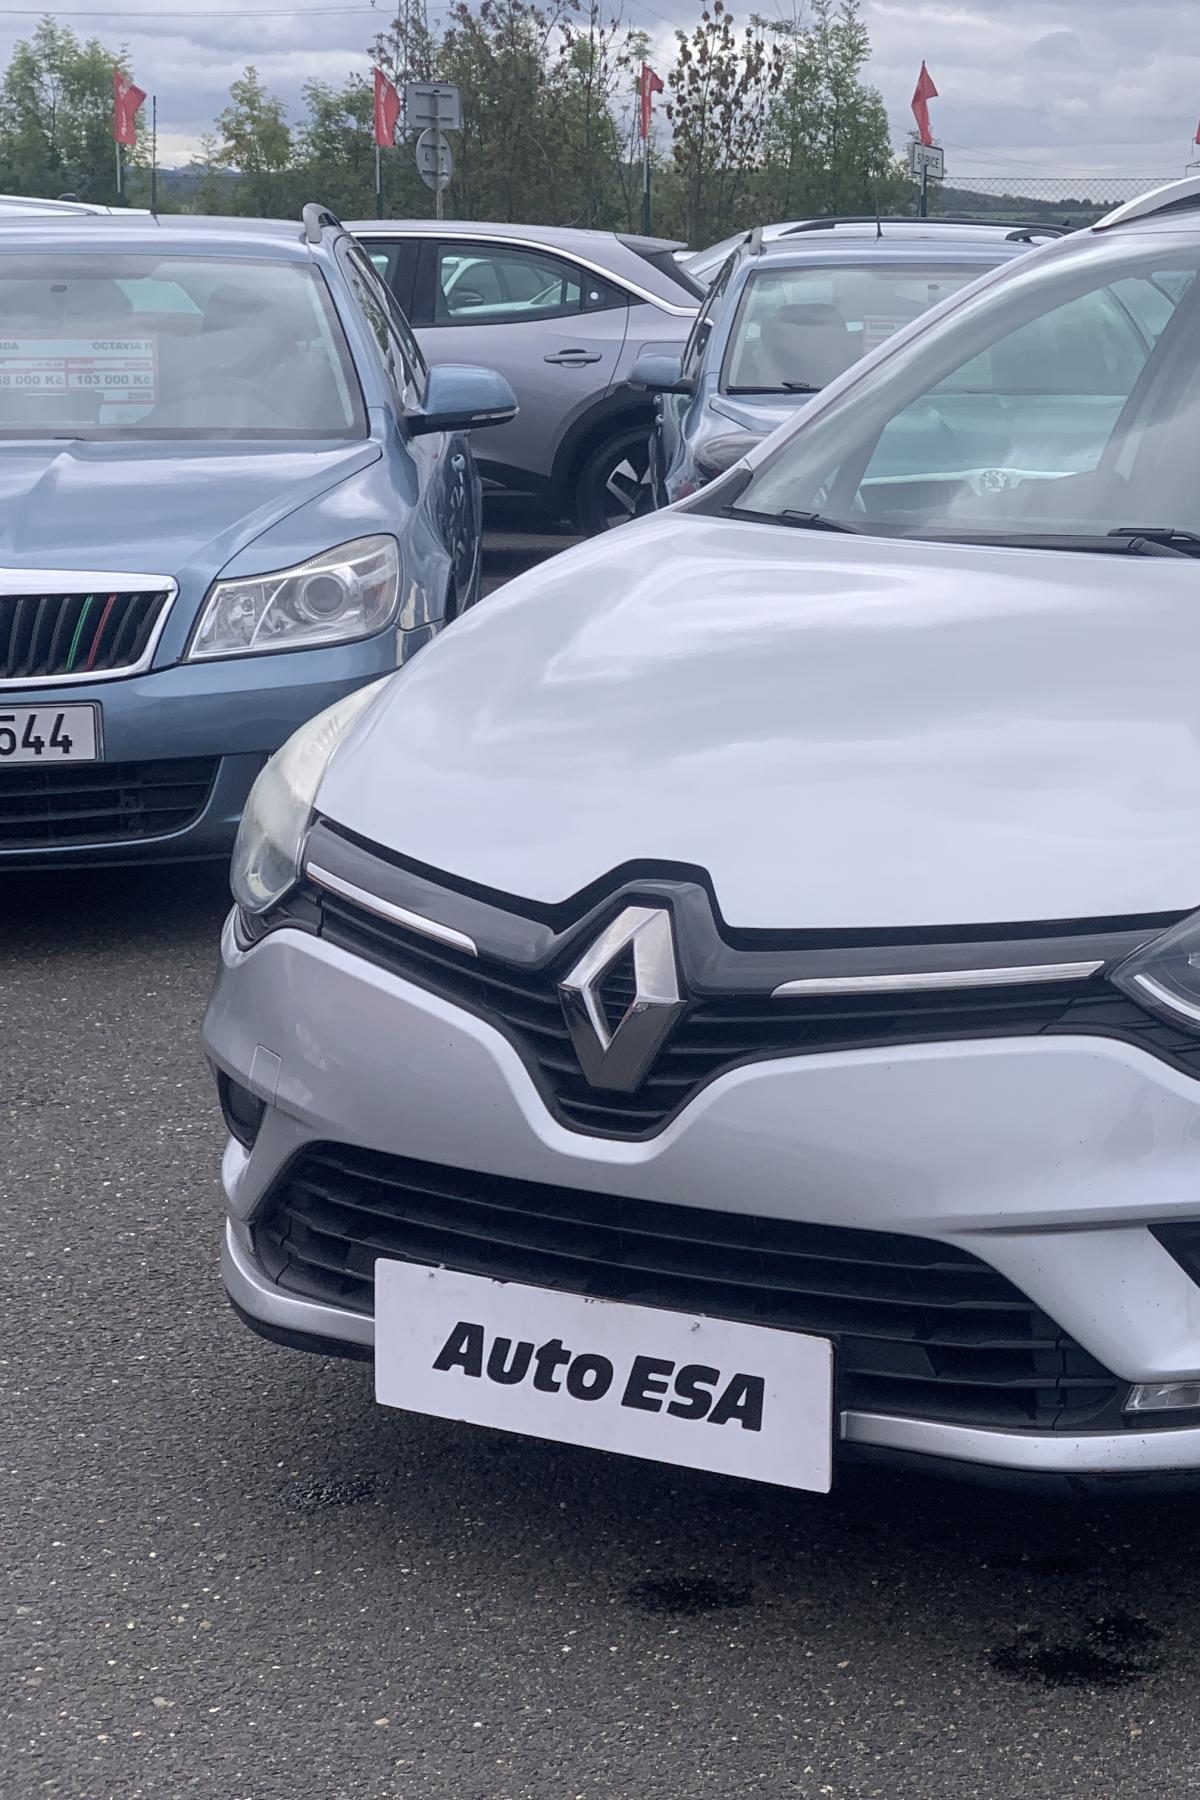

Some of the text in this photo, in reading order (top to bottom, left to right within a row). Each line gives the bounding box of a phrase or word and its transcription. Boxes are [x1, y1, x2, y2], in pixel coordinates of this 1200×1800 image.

[92, 342, 142, 350] OCTAVIA
[15, 375, 41, 385] 000
[45, 375, 64, 385] Kč
[76, 374, 152, 385] 103 000 Kč
[0, 713, 73, 755] 544
[432, 1321, 766, 1432] Auto ESA
